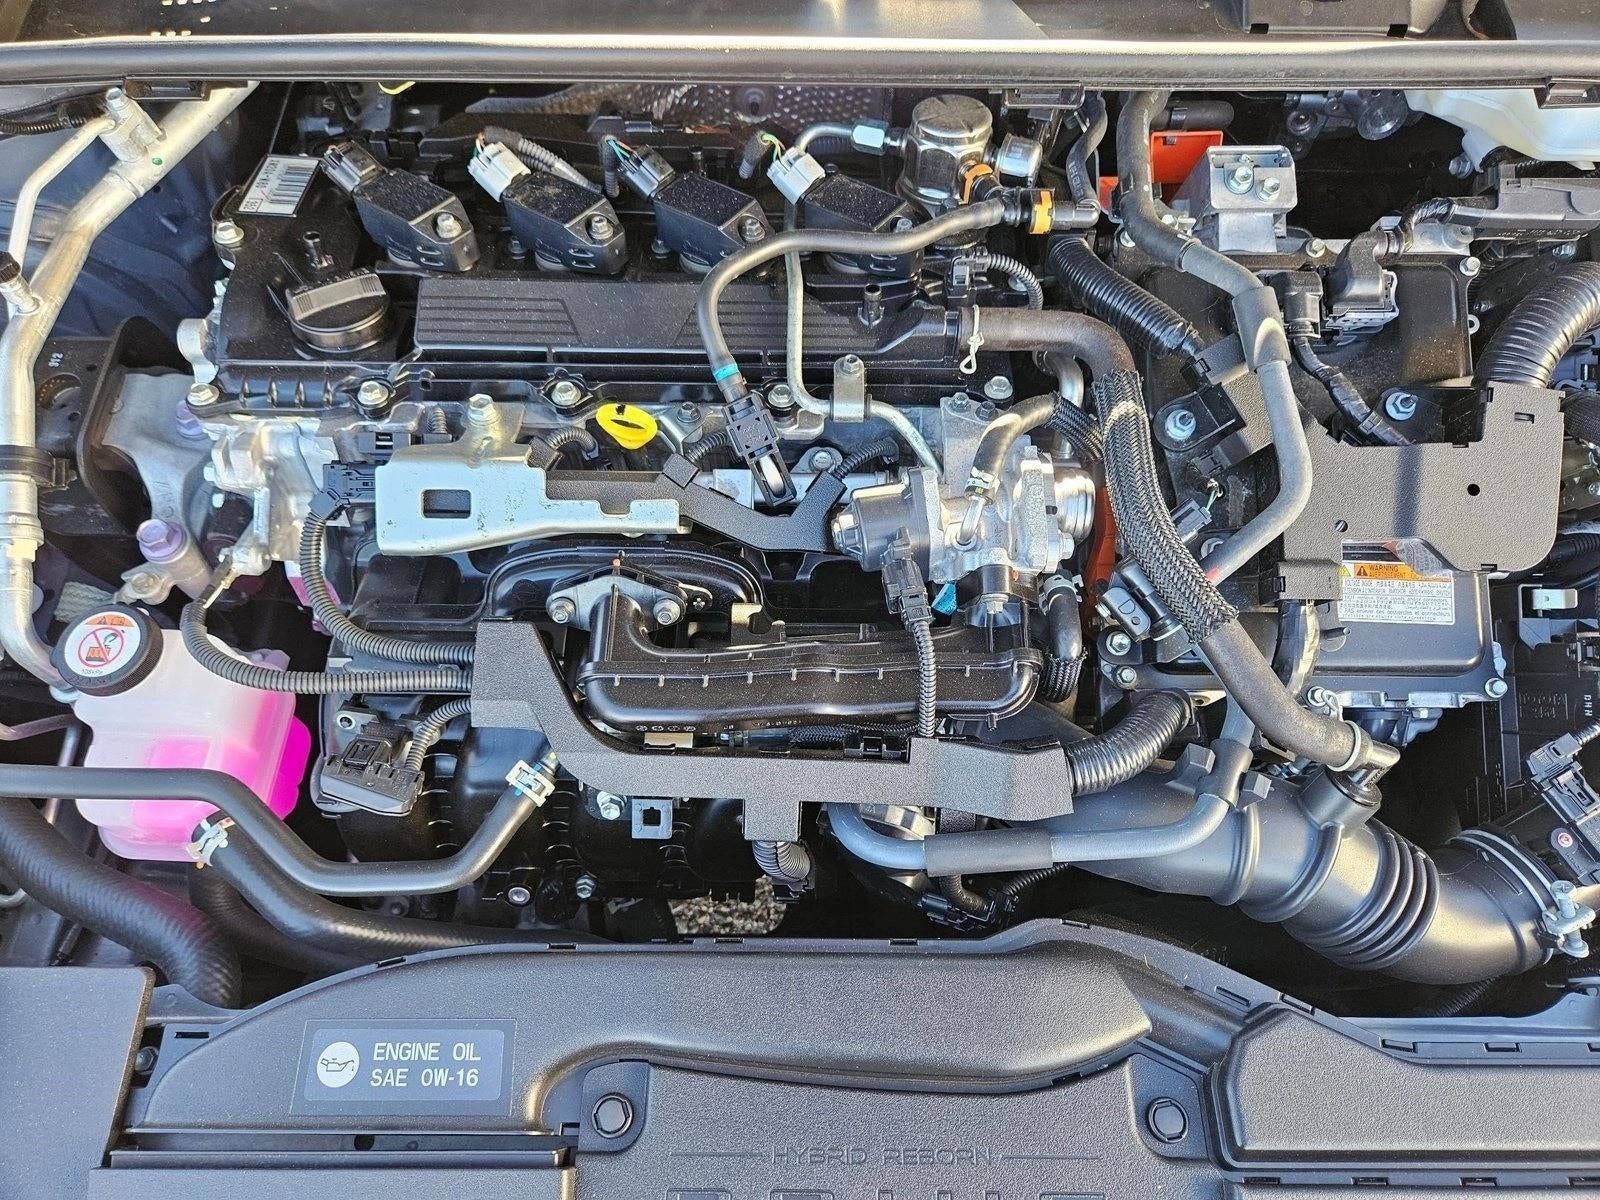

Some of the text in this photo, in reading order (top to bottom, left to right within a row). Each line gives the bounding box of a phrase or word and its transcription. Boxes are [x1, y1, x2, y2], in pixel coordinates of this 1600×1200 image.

[373, 1042, 482, 1061] ENGINE OIL
[370, 1068, 409, 1087] SAE
[772, 1146, 992, 1167] HYBRID REBORN
